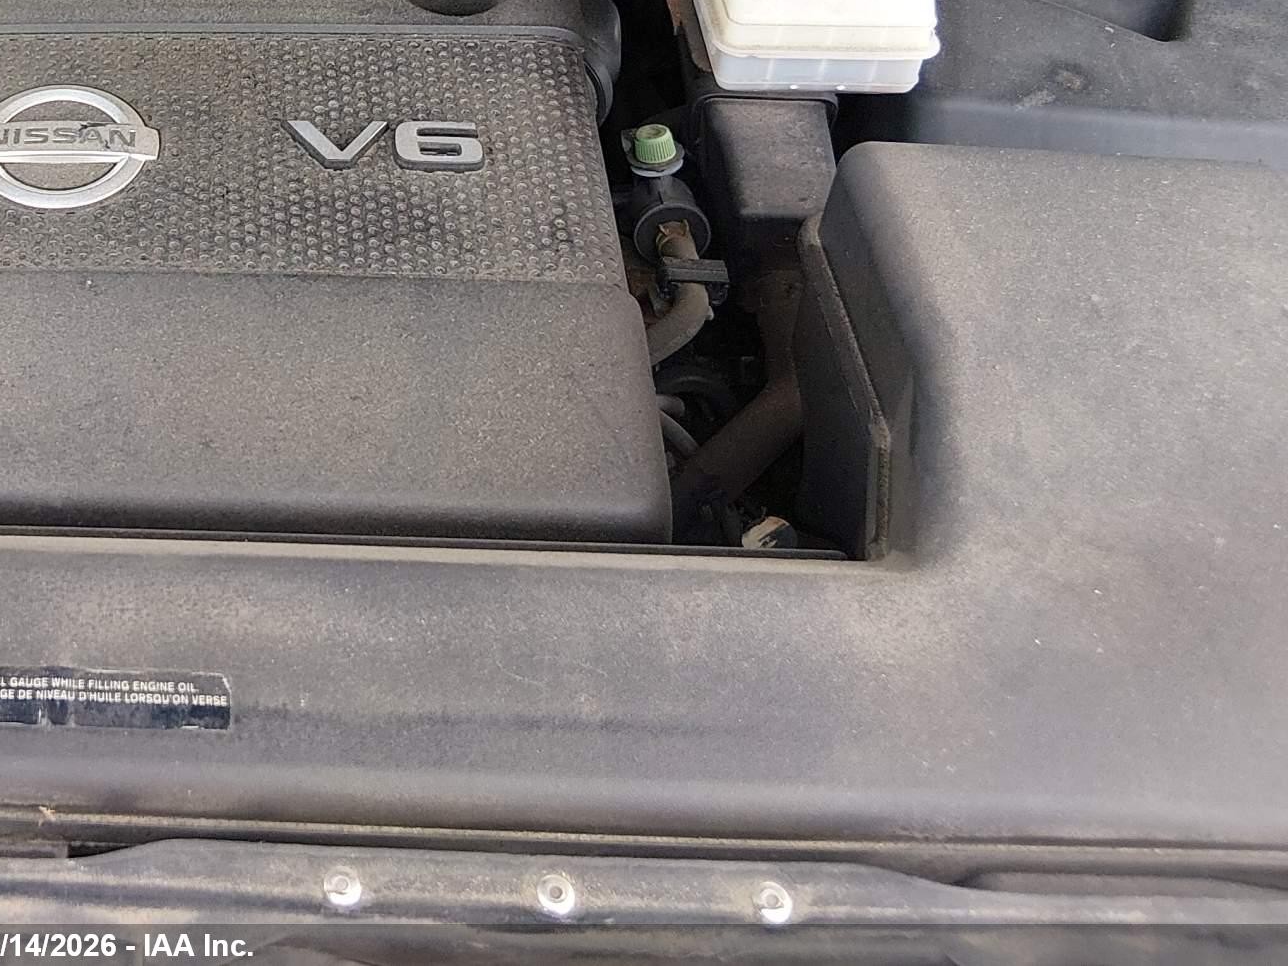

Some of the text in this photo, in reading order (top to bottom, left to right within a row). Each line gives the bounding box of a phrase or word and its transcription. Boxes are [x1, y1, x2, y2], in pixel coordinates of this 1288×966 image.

[285, 119, 486, 172] V6
[10, 676, 48, 688] GAUGE
[52, 678, 85, 689] WHILE
[88, 679, 129, 691] FILLING
[133, 680, 175, 692] ENGINE
[18, 689, 32, 700] DE
[36, 690, 75, 702] NIVEAU
[79, 691, 121, 703] D'HUILE
[125, 692, 189, 705] LORSQU'ON
[192, 694, 228, 707] VERSE
